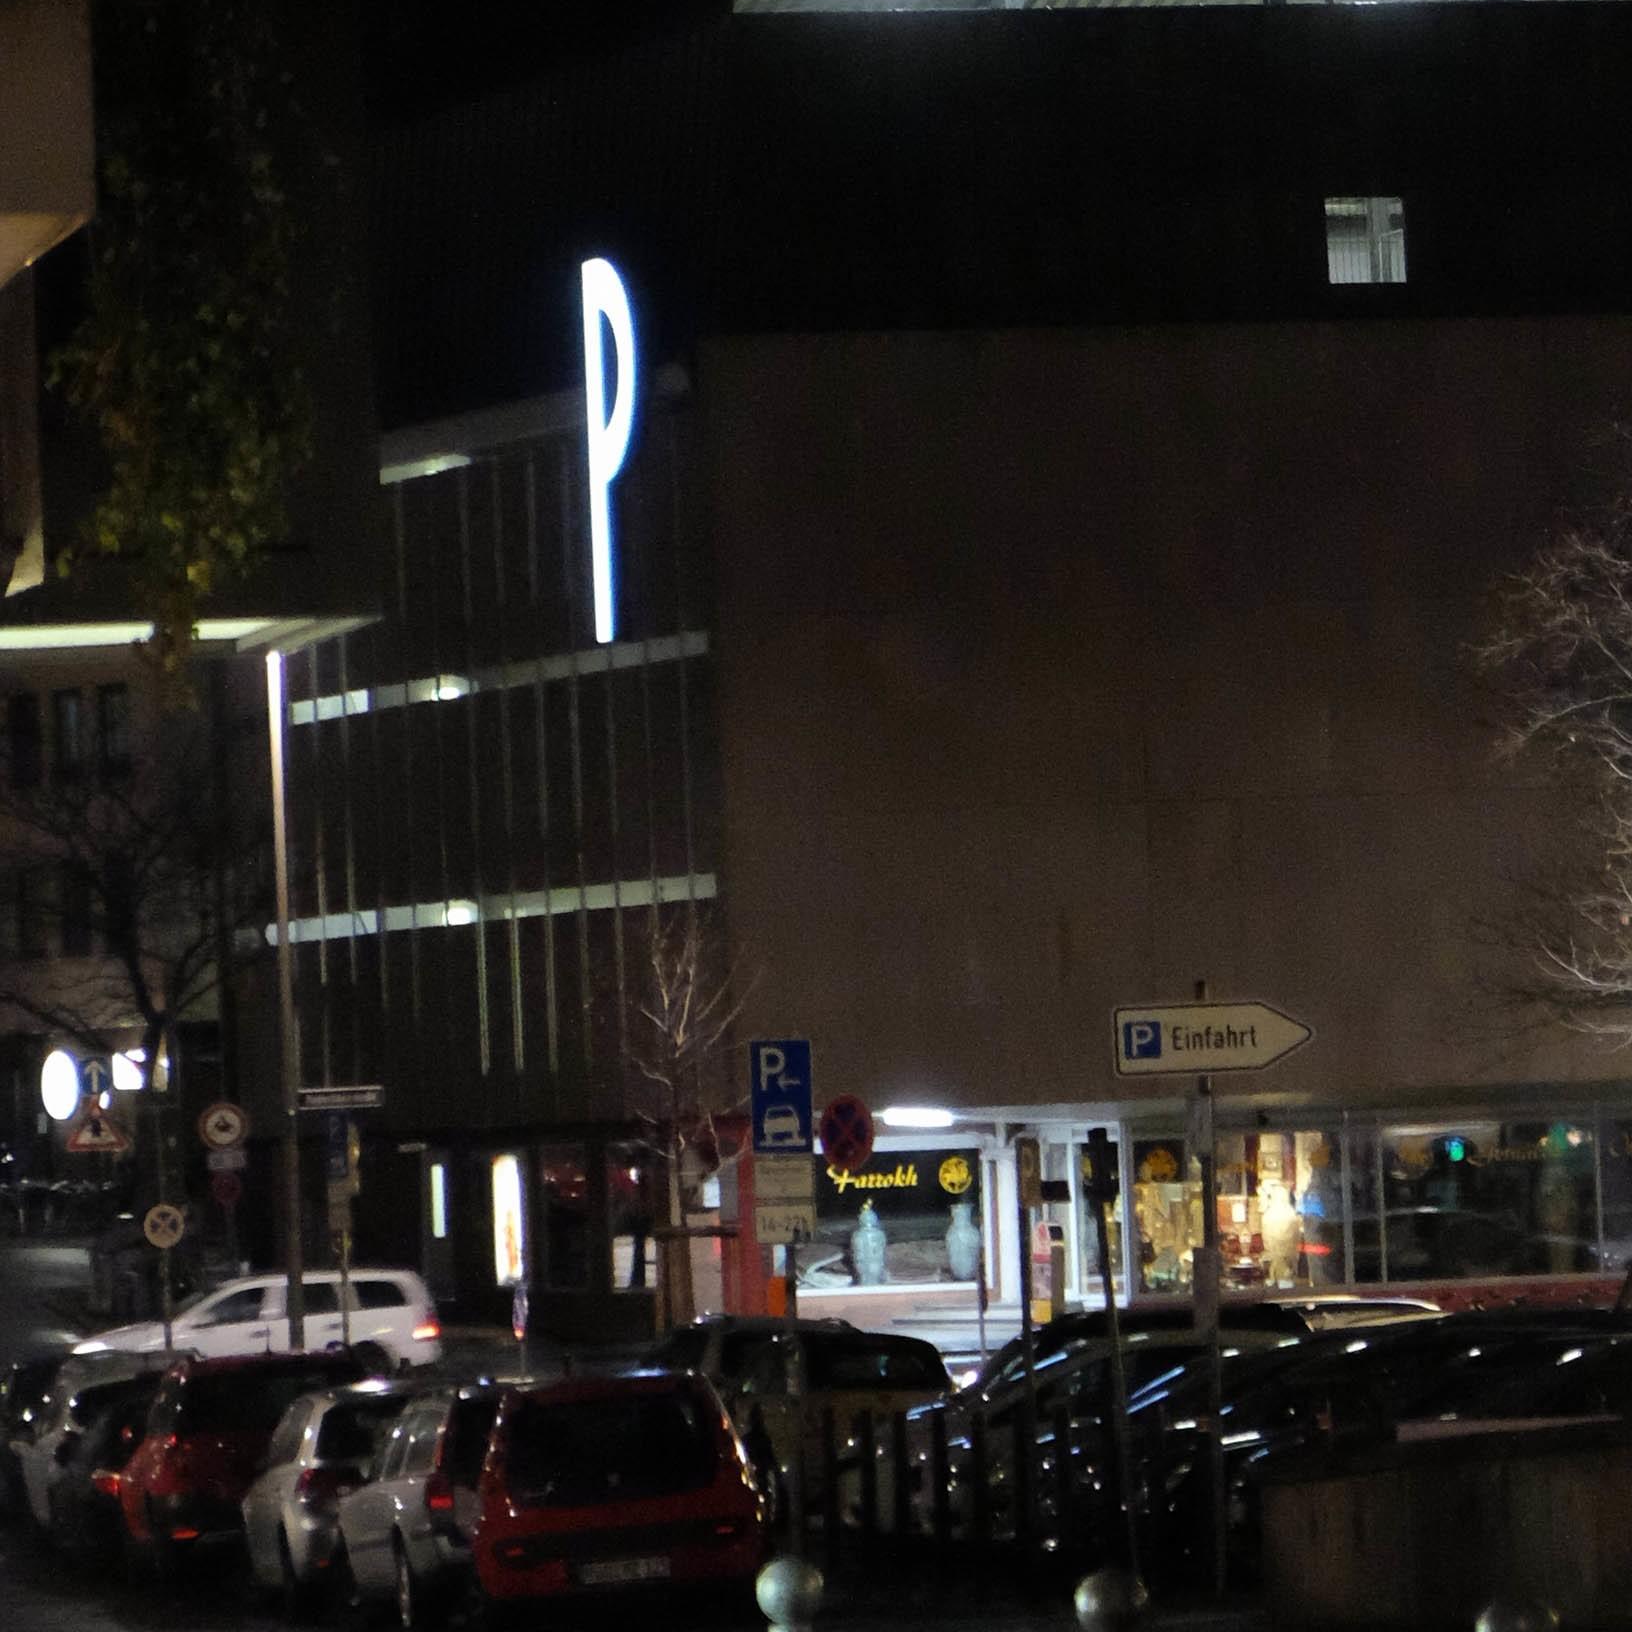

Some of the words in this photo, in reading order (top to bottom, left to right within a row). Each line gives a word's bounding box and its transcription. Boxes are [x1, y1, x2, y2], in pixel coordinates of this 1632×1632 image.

[1130, 1023, 1154, 1057] P
[1171, 1024, 1257, 1052] Einfahrt
[759, 1046, 785, 1092] P
